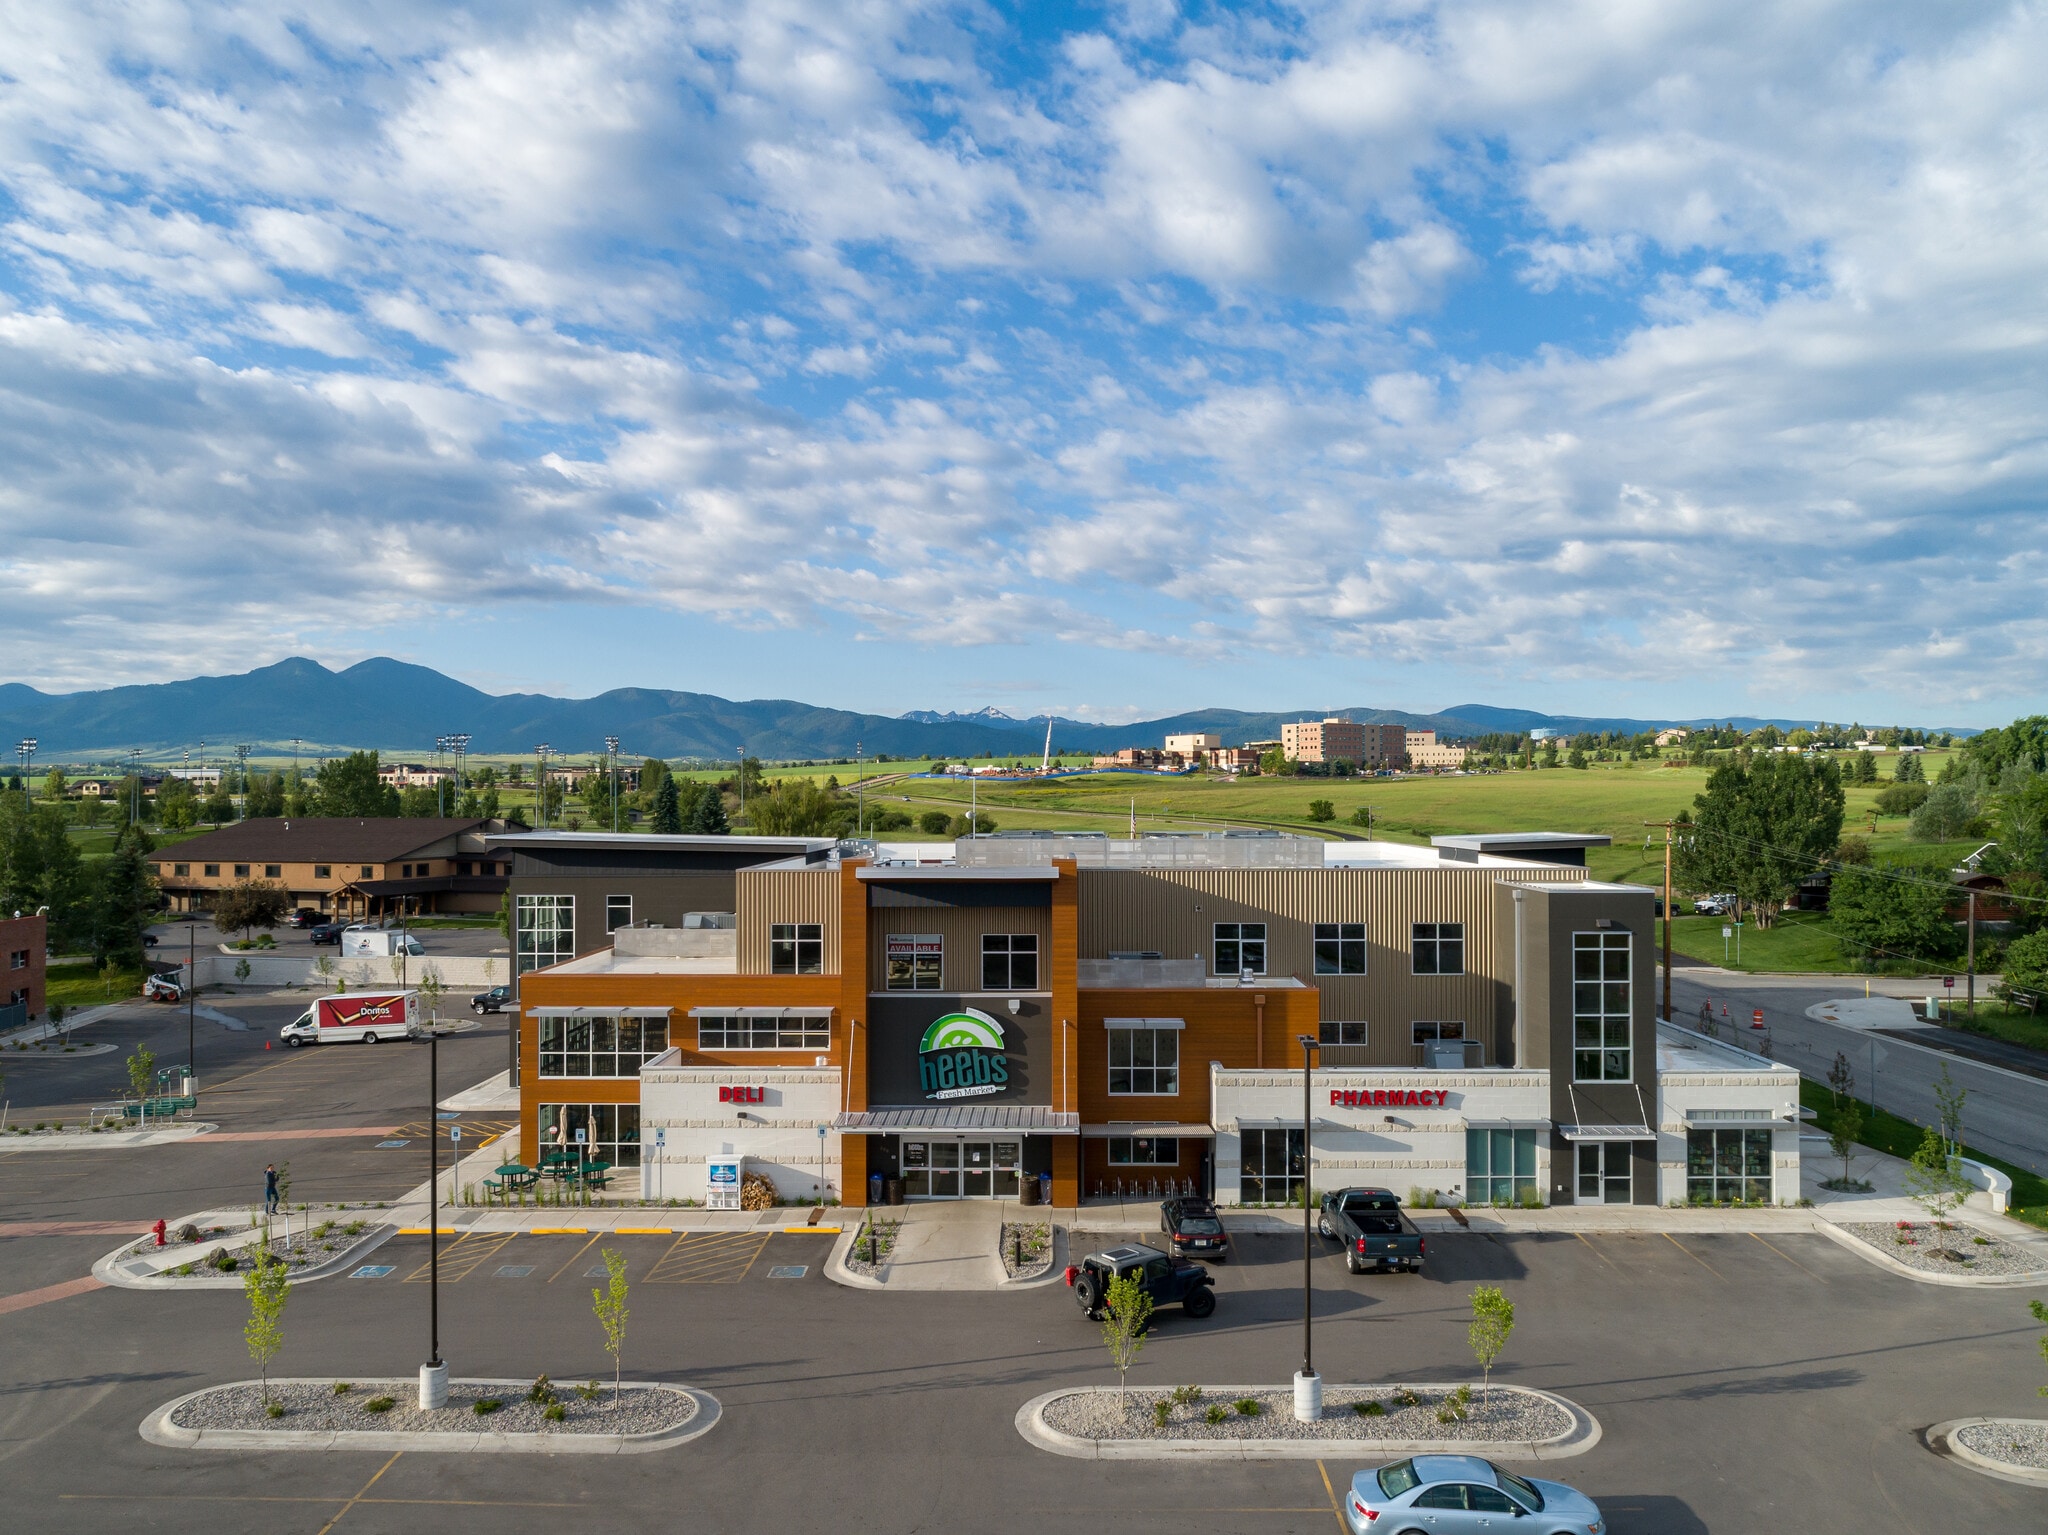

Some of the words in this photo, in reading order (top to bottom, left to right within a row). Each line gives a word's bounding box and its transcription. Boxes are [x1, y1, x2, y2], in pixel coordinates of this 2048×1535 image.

[360, 1007, 390, 1015] Doritos
[919, 1049, 1008, 1090] heebs
[719, 1086, 764, 1102] DELI
[938, 1090, 963, 1099] Fresh
[964, 1086, 994, 1096] Market
[1330, 1090, 1448, 1106] PHARMACY
